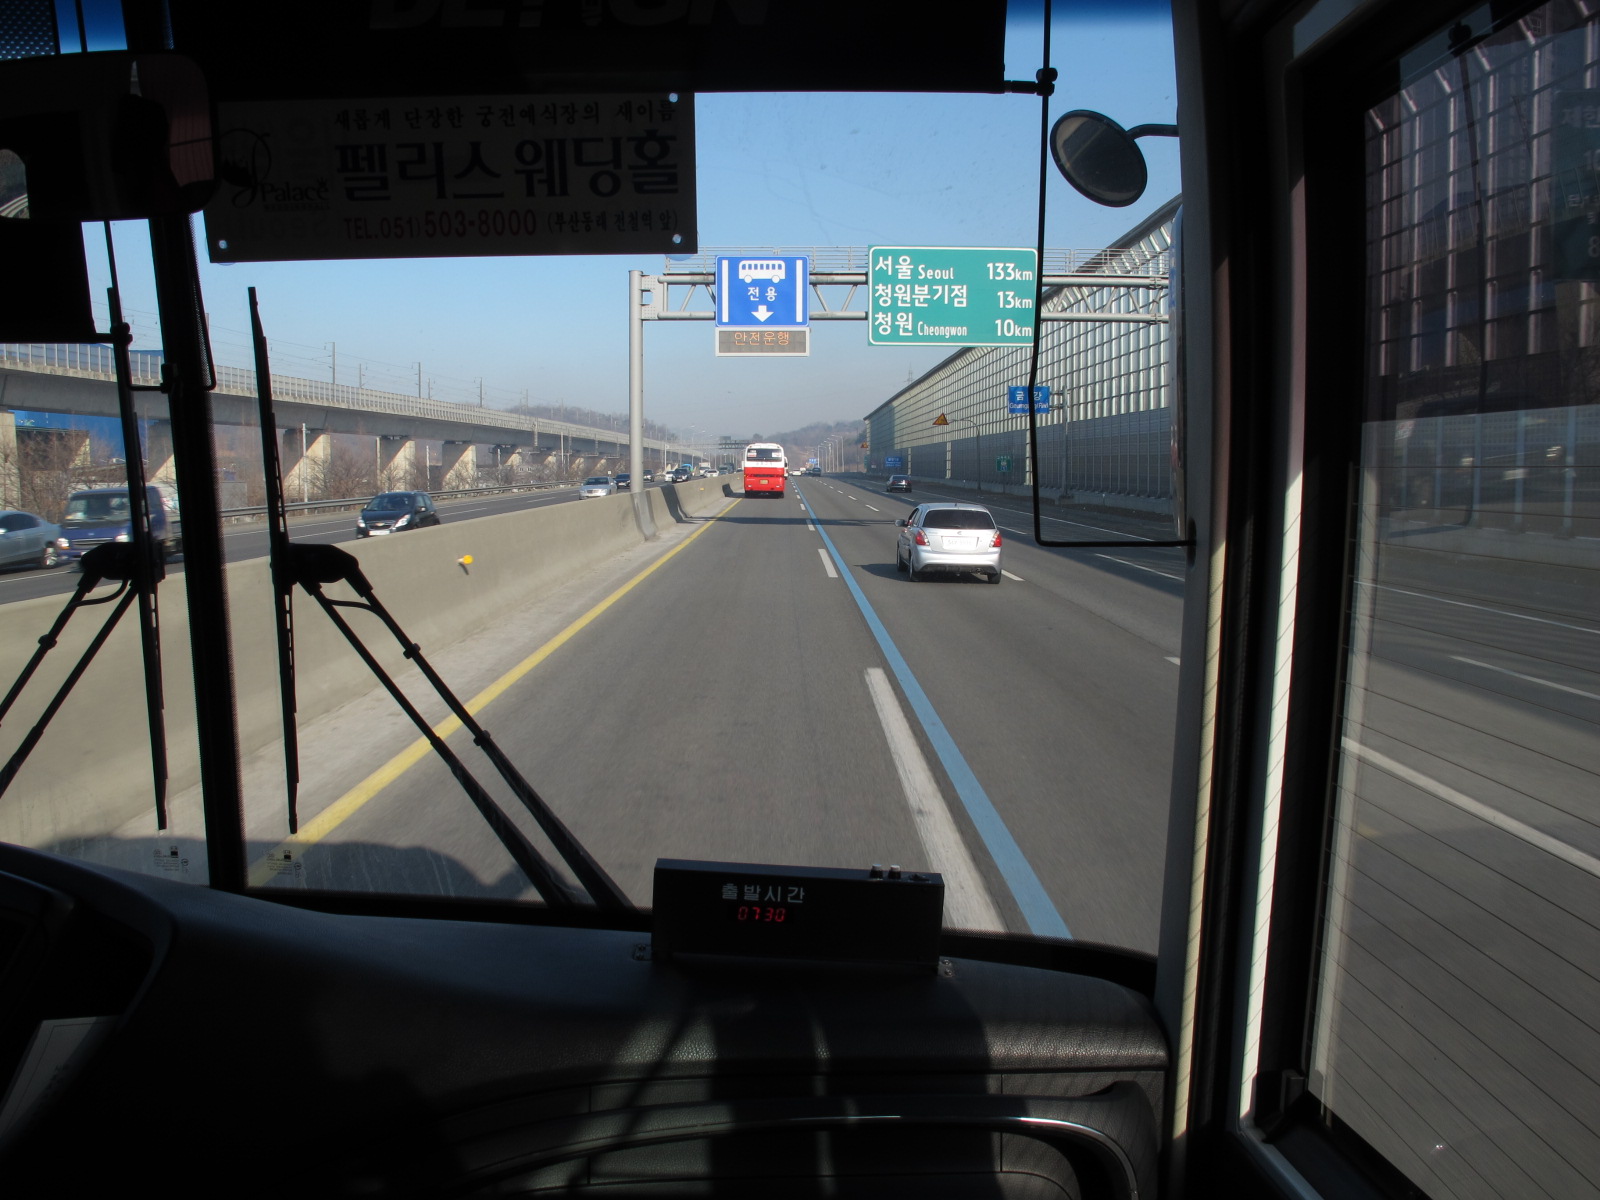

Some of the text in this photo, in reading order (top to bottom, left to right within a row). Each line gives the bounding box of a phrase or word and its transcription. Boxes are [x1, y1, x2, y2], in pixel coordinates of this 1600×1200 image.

[335, 100, 676, 131] 새롭게 단장한 궁전예식장의 새이름
[261, 182, 330, 202] Palace
[875, 255, 914, 280] 서울
[918, 264, 954, 280] Seoul
[875, 284, 967, 307] 청원분기점
[875, 312, 913, 336] 청원
[918, 321, 967, 338] Cheongwon
[734, 331, 789, 346] 안전운행
[721, 882, 806, 904] 출발시간
[737, 905, 787, 923] 0730
